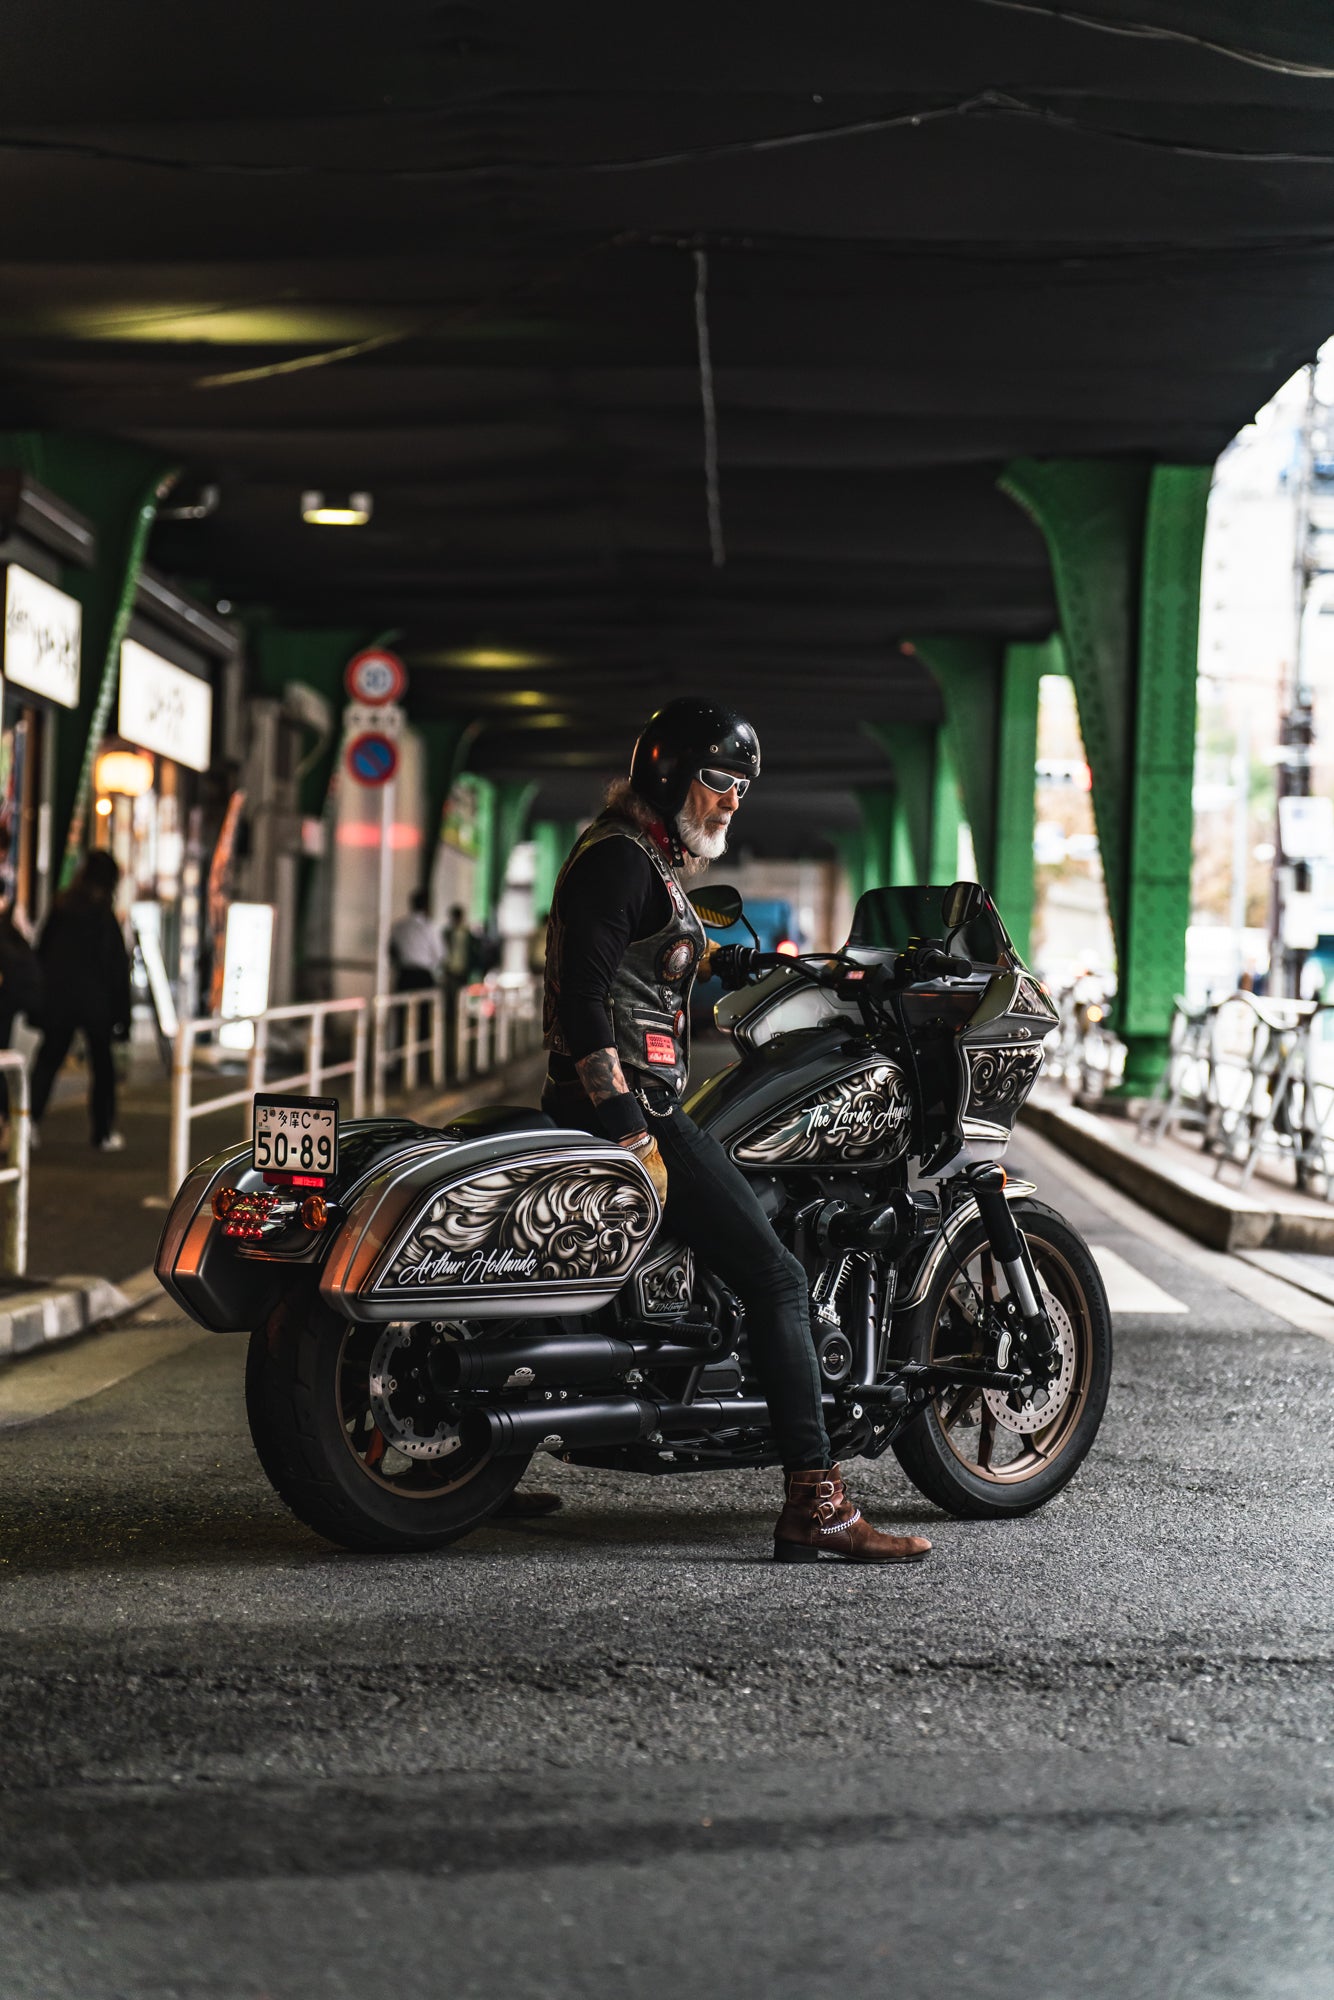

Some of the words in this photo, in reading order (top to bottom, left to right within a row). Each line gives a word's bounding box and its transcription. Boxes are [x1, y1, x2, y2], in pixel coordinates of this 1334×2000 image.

[802, 1104, 831, 1138] The
[257, 1131, 332, 1170] 50-89
[398, 1249, 465, 1285] Arthur
[462, 1248, 537, 1284] Hollands
